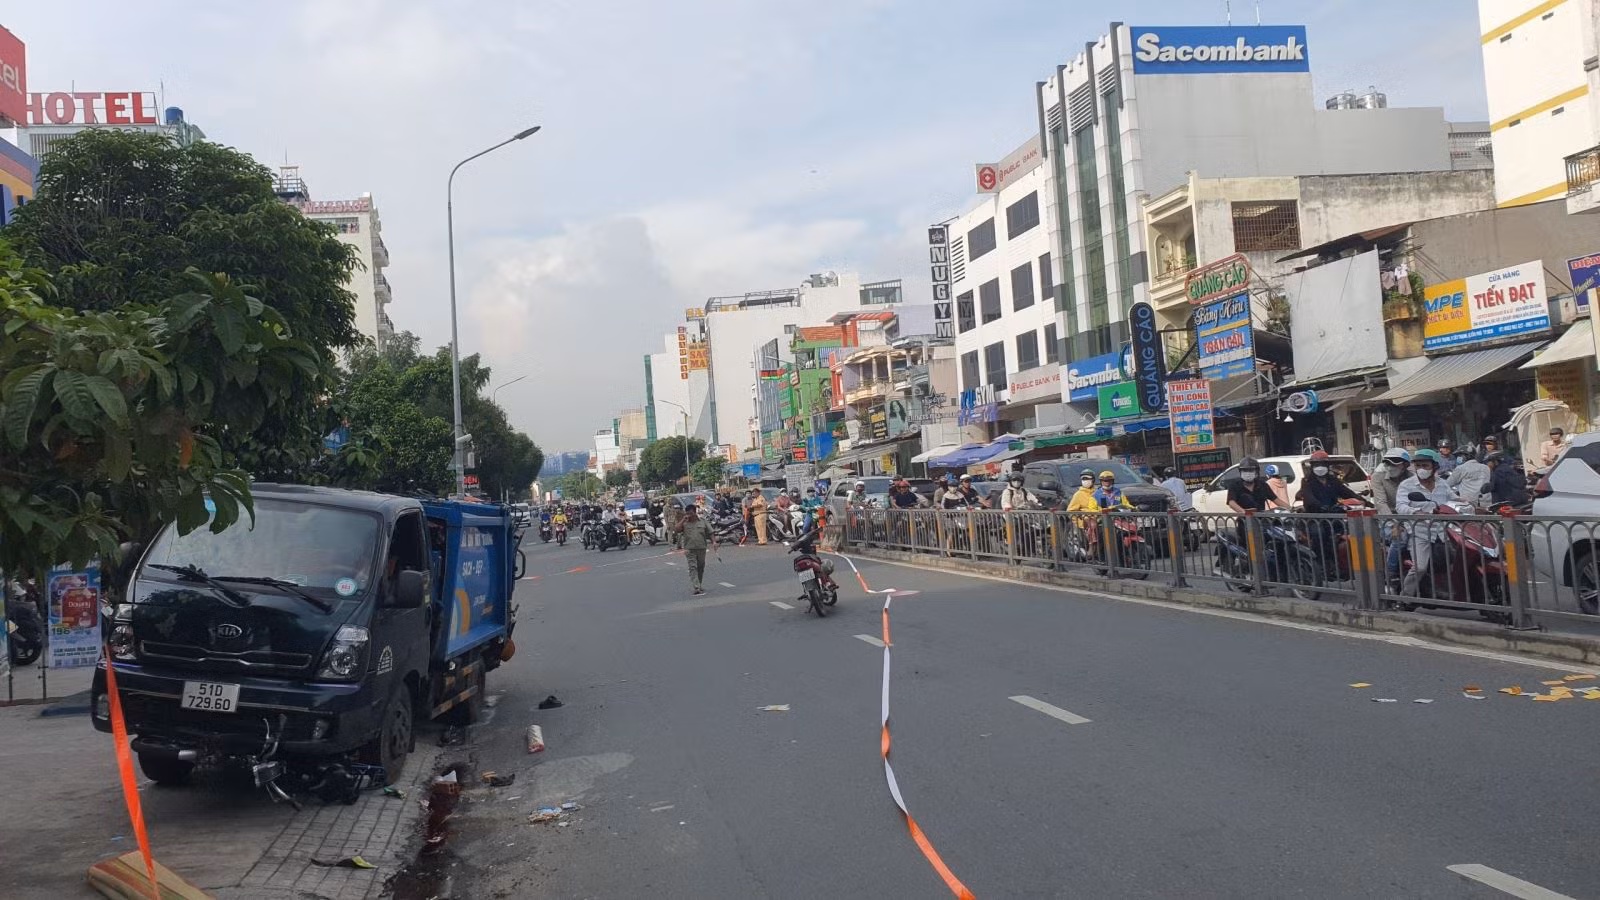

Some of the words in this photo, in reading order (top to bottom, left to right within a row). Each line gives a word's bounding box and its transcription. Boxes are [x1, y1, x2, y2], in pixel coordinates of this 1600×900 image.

[1136, 33, 1305, 63] Sacombank
[0, 60, 22, 95] el
[26, 92, 156, 124] HOTEL
[1004, 160, 1021, 176] PUBLIC
[1023, 148, 1038, 163] BANK
[304, 200, 369, 213] MASSAGE
[1224, 262, 1246, 288] CÁO
[1502, 269, 1520, 280] HÀNG
[1424, 291, 1465, 315] MPE
[1474, 284, 1505, 310] TIẾN
[1509, 281, 1536, 305] ĐẠT
[1136, 306, 1153, 343] CÁO
[1016, 380, 1034, 392] PUBLIC
[1035, 376, 1051, 387] BANK
[1069, 363, 1120, 390] Sacomba
[1140, 347, 1161, 407] QUẢNG
[1175, 433, 1212, 446] LED
[217, 625, 237, 637] KIA
[187, 695, 231, 711] 729.60
[198, 683, 223, 697] 51D
